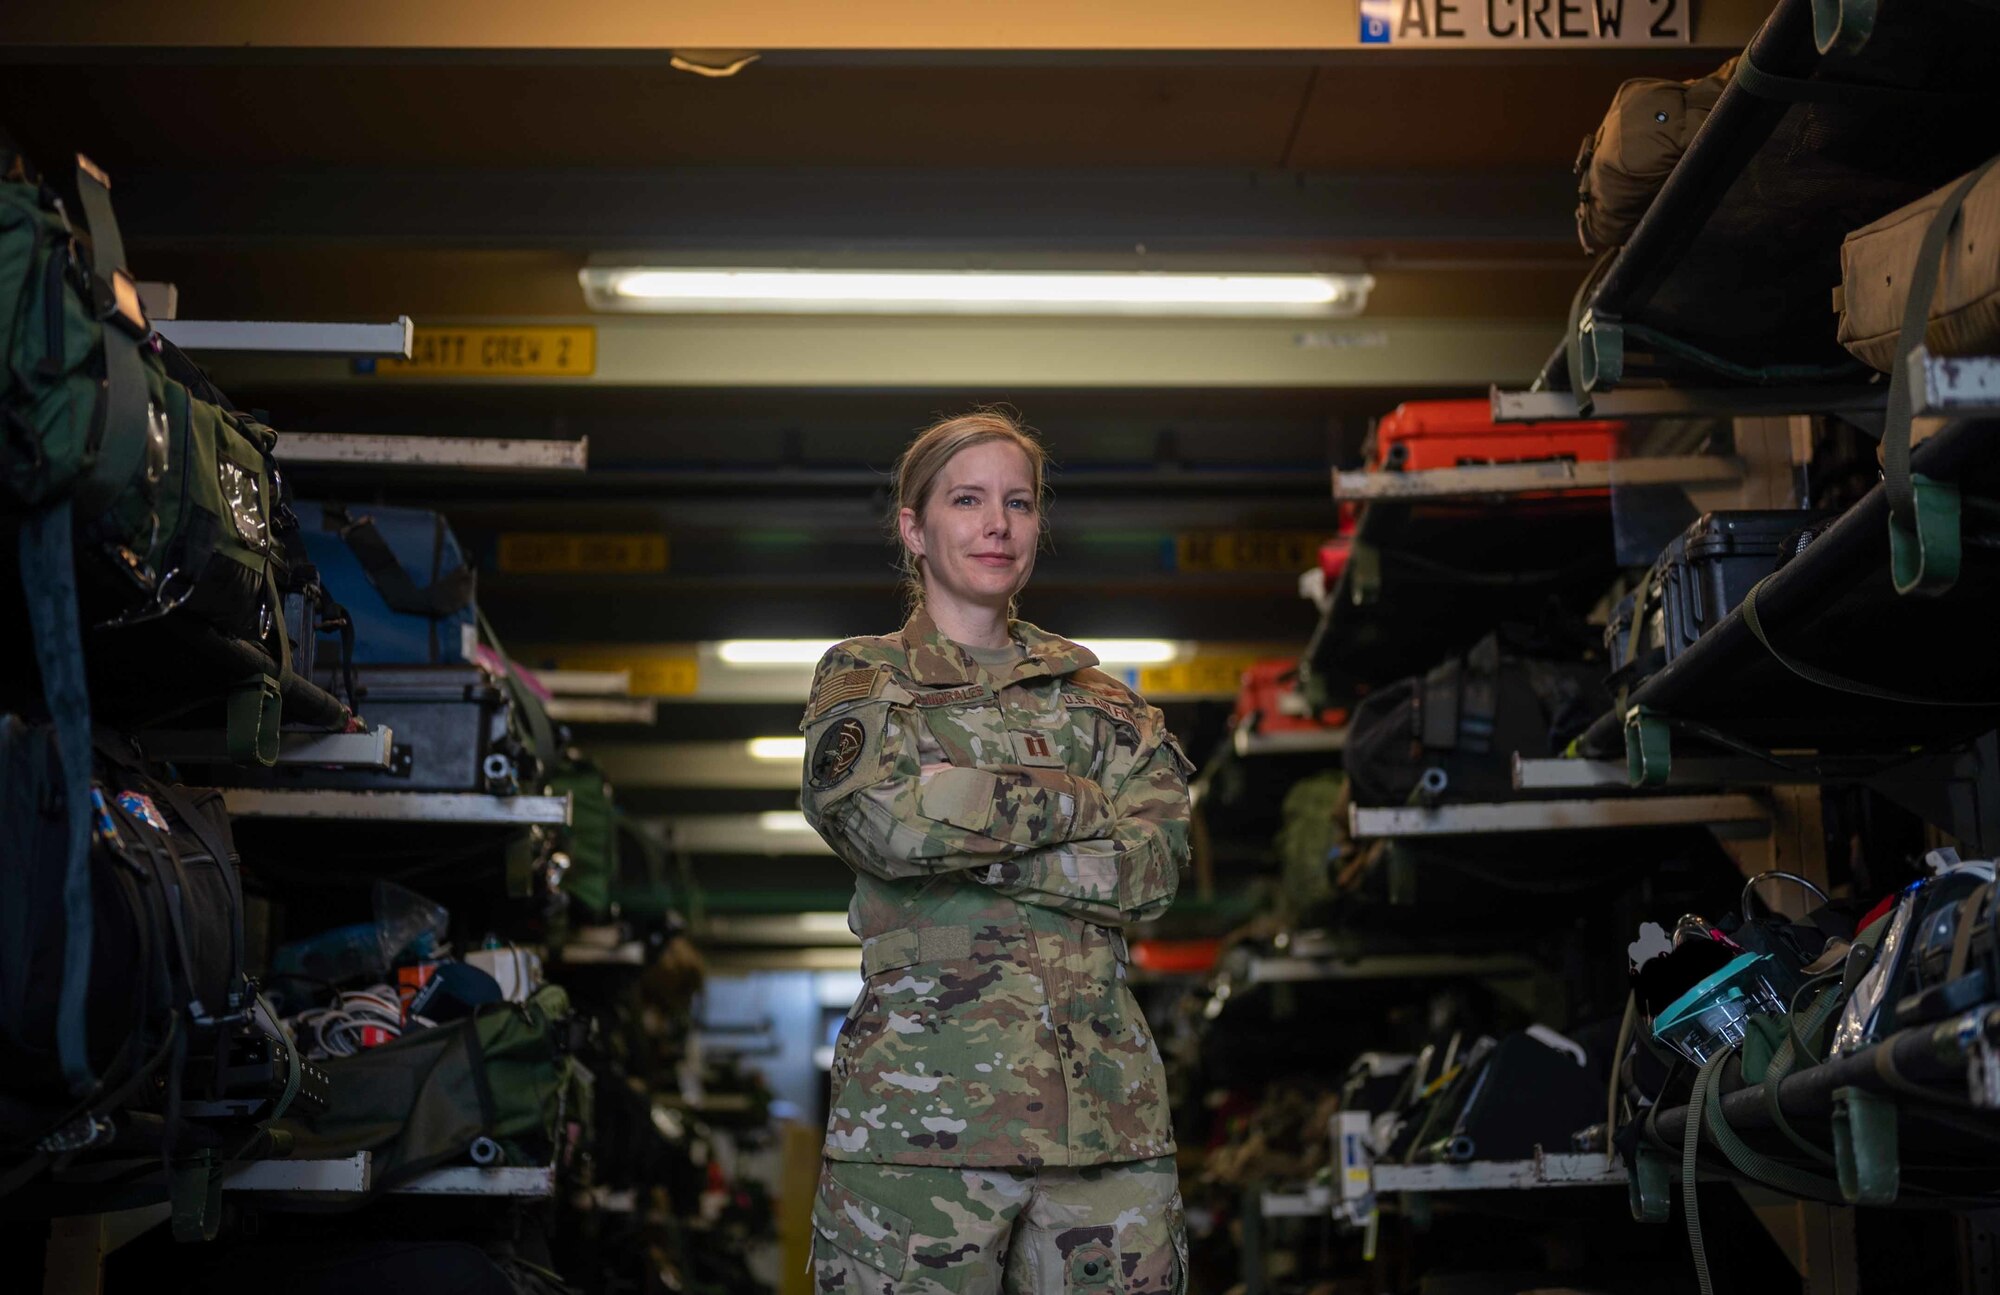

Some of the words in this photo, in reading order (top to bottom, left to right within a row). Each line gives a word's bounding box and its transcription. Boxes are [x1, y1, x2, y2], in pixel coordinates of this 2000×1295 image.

[1398, 0, 1465, 38] AE
[1485, 0, 1623, 38] CREW
[1650, 0, 1678, 38] 2
[481, 335, 543, 368] CREW
[1063, 695, 1091, 704] U.S.
[1093, 698, 1113, 714] AIR
